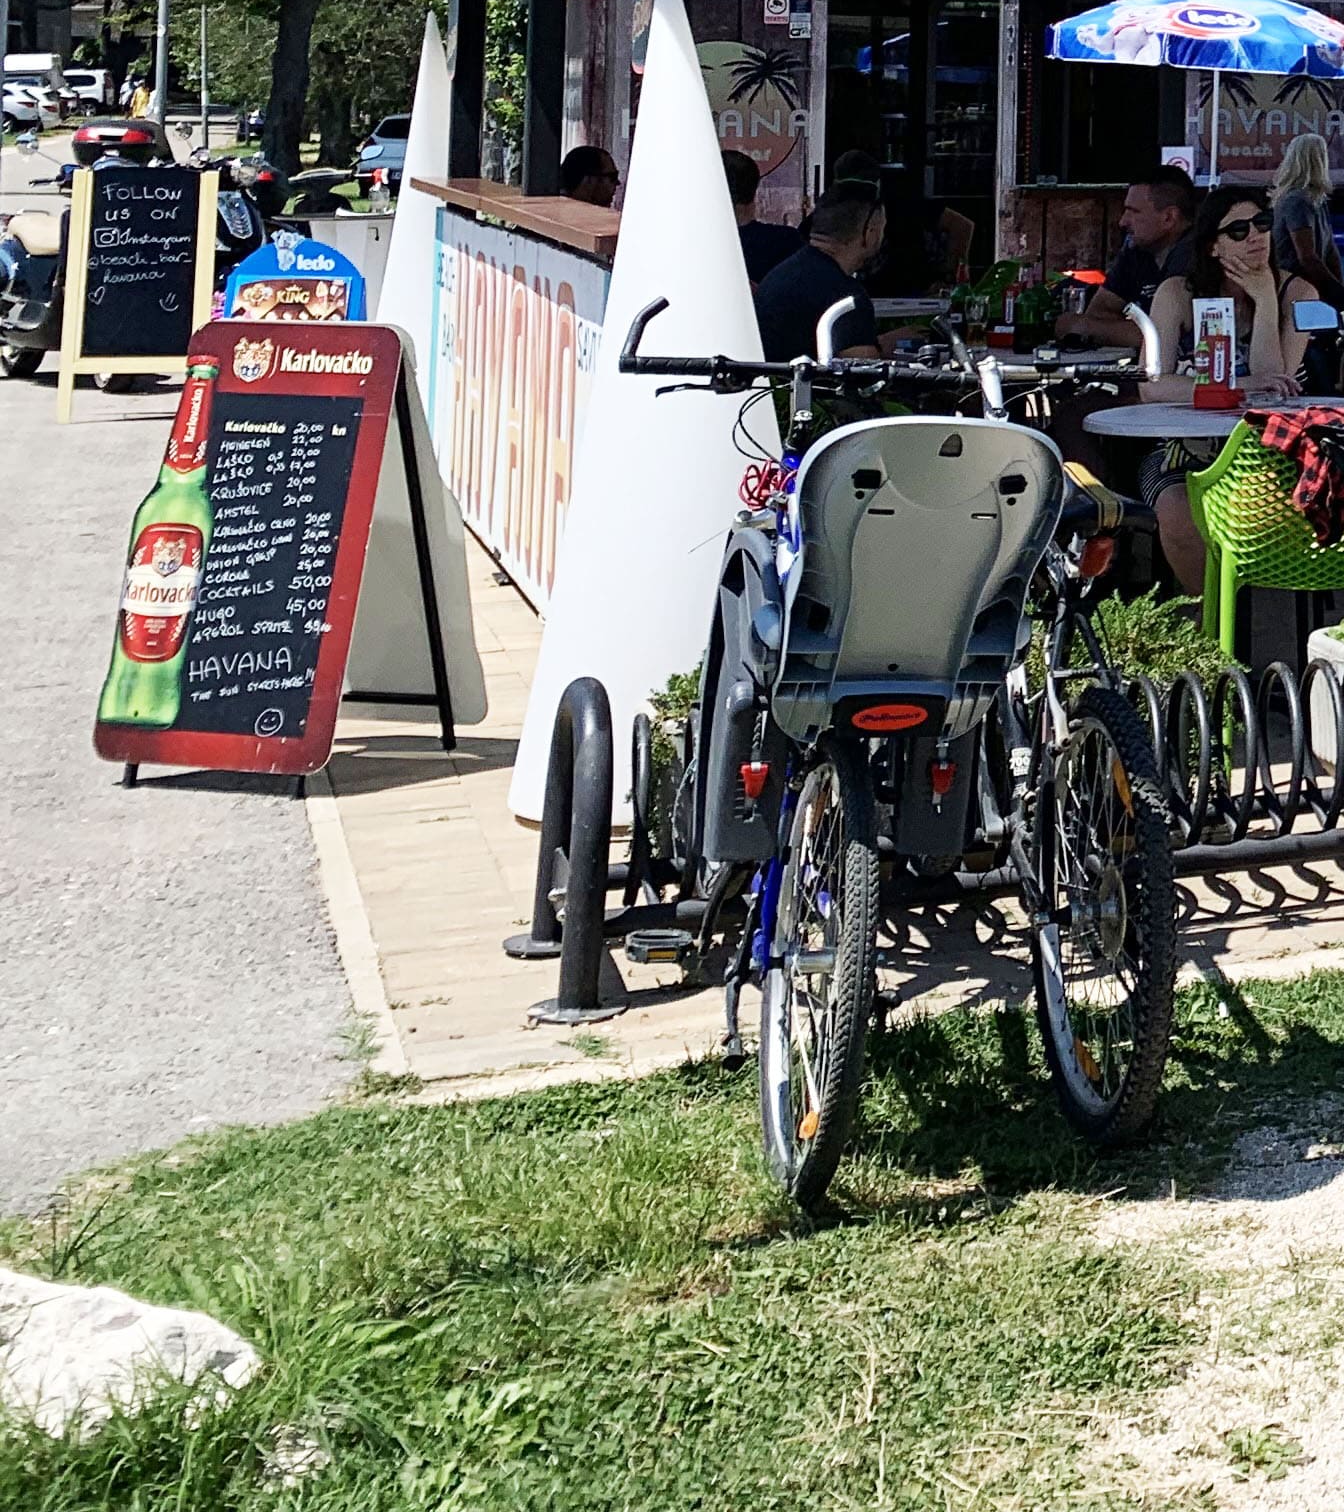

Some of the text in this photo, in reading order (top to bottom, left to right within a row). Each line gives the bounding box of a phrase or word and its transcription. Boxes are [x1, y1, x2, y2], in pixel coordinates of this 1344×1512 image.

[1187, 10, 1252, 25] ledo
[102, 183, 182, 201] FOLLOW
[151, 207, 179, 220] ON
[119, 228, 192, 250] Instagram
[297, 255, 335, 271] ledo
[275, 289, 310, 304] KING
[280, 347, 373, 375] Karlovačko
[332, 424, 347, 436] kn
[214, 504, 260, 520] AMSTEL
[199, 576, 332, 604] COCKTAILS 50,00
[286, 597, 326, 617] 45,00
[188, 647, 292, 683] HAVANA
